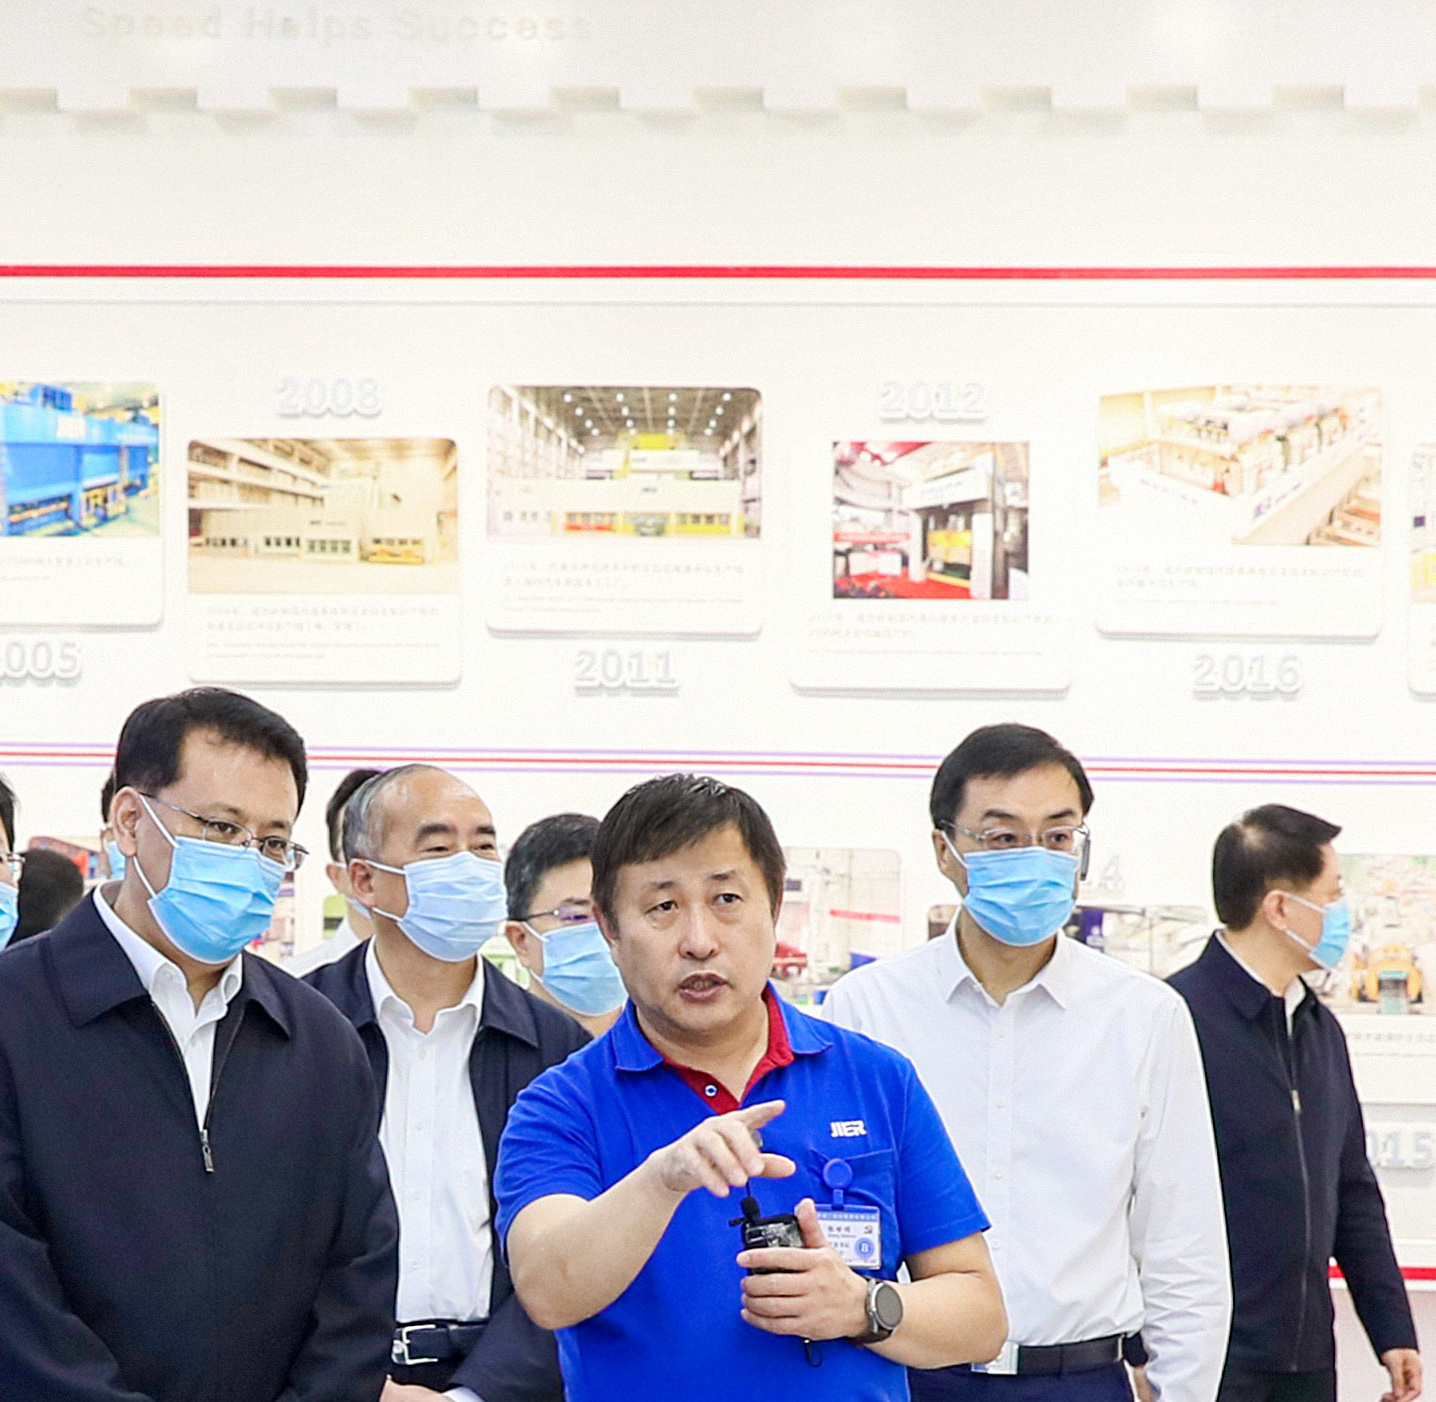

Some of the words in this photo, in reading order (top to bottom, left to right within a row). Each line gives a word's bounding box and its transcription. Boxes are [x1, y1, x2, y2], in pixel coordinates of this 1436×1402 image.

[275, 376, 380, 417] 2008
[878, 380, 988, 420] 2012
[574, 648, 677, 690] 2011
[1190, 653, 1302, 695] 2016
